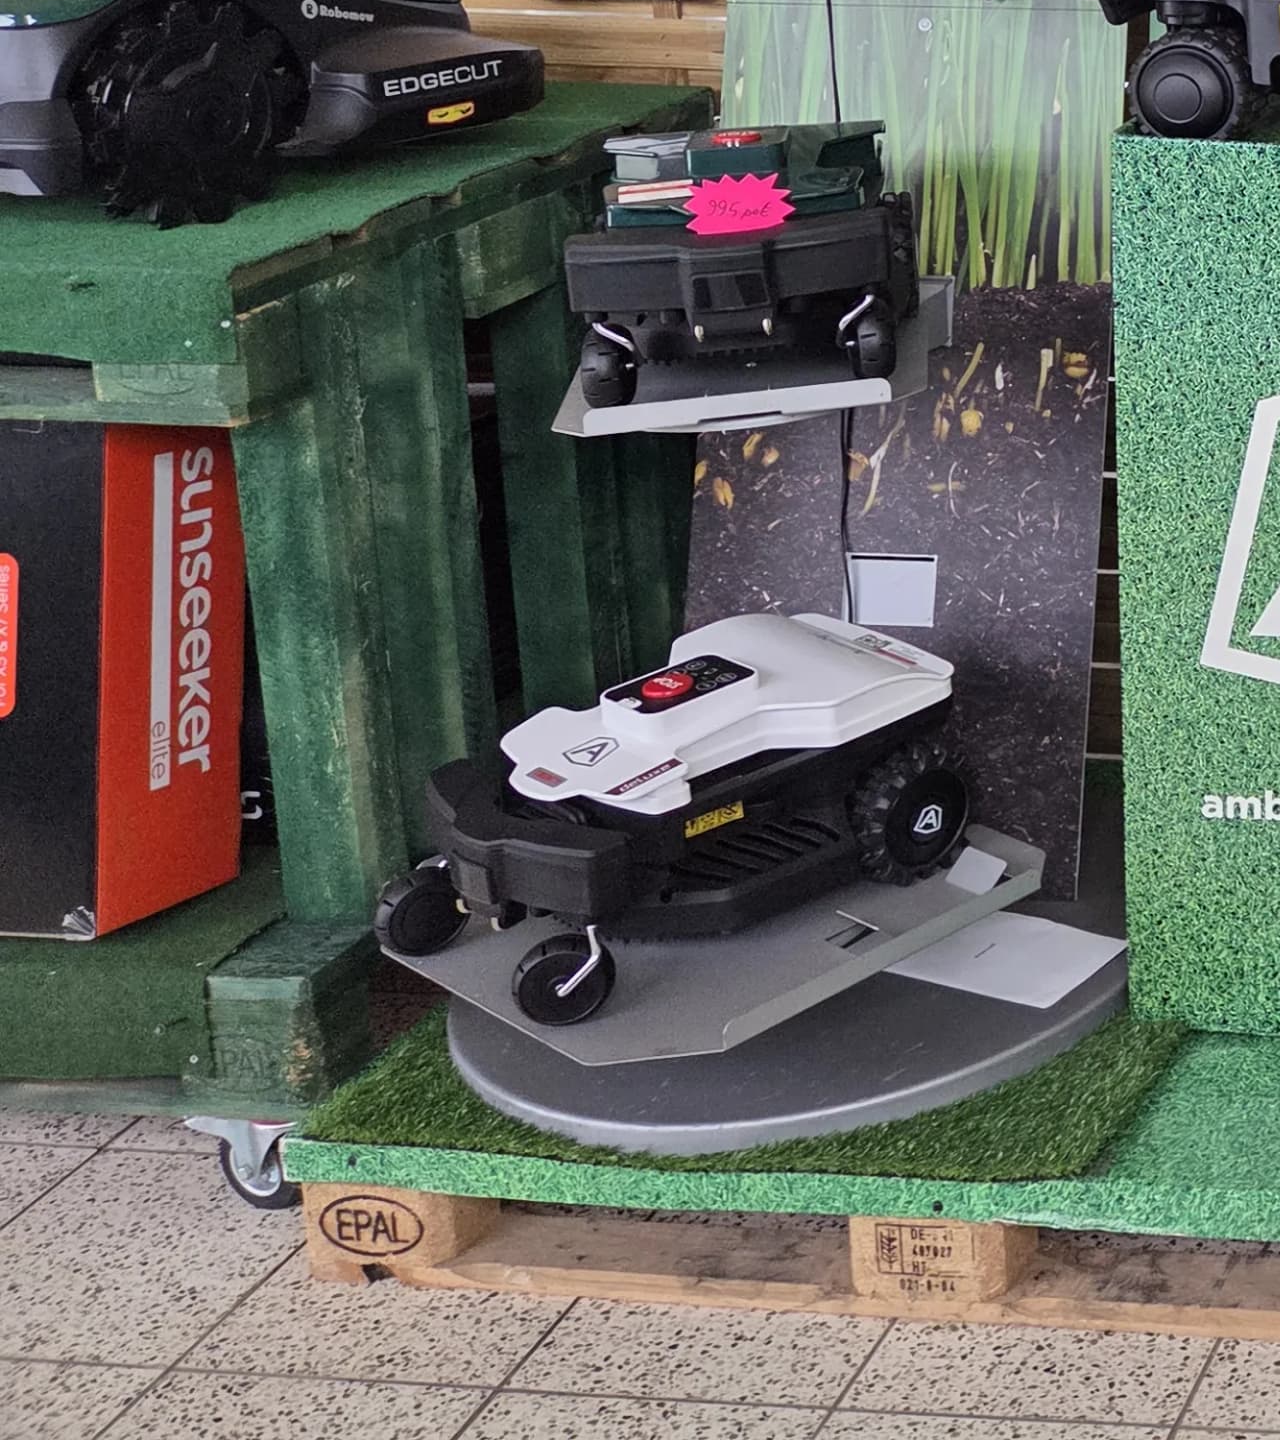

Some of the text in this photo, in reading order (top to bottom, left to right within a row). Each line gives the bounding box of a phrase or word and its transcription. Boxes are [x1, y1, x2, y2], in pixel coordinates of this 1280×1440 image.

[320, 5, 374, 23] Robomow
[383, 60, 502, 97] EDGECUT
[178, 447, 213, 773] sunseeker
[149, 720, 167, 780] elite
[619, 764, 671, 794] deluxe
[336, 1208, 409, 1243] EPAL
